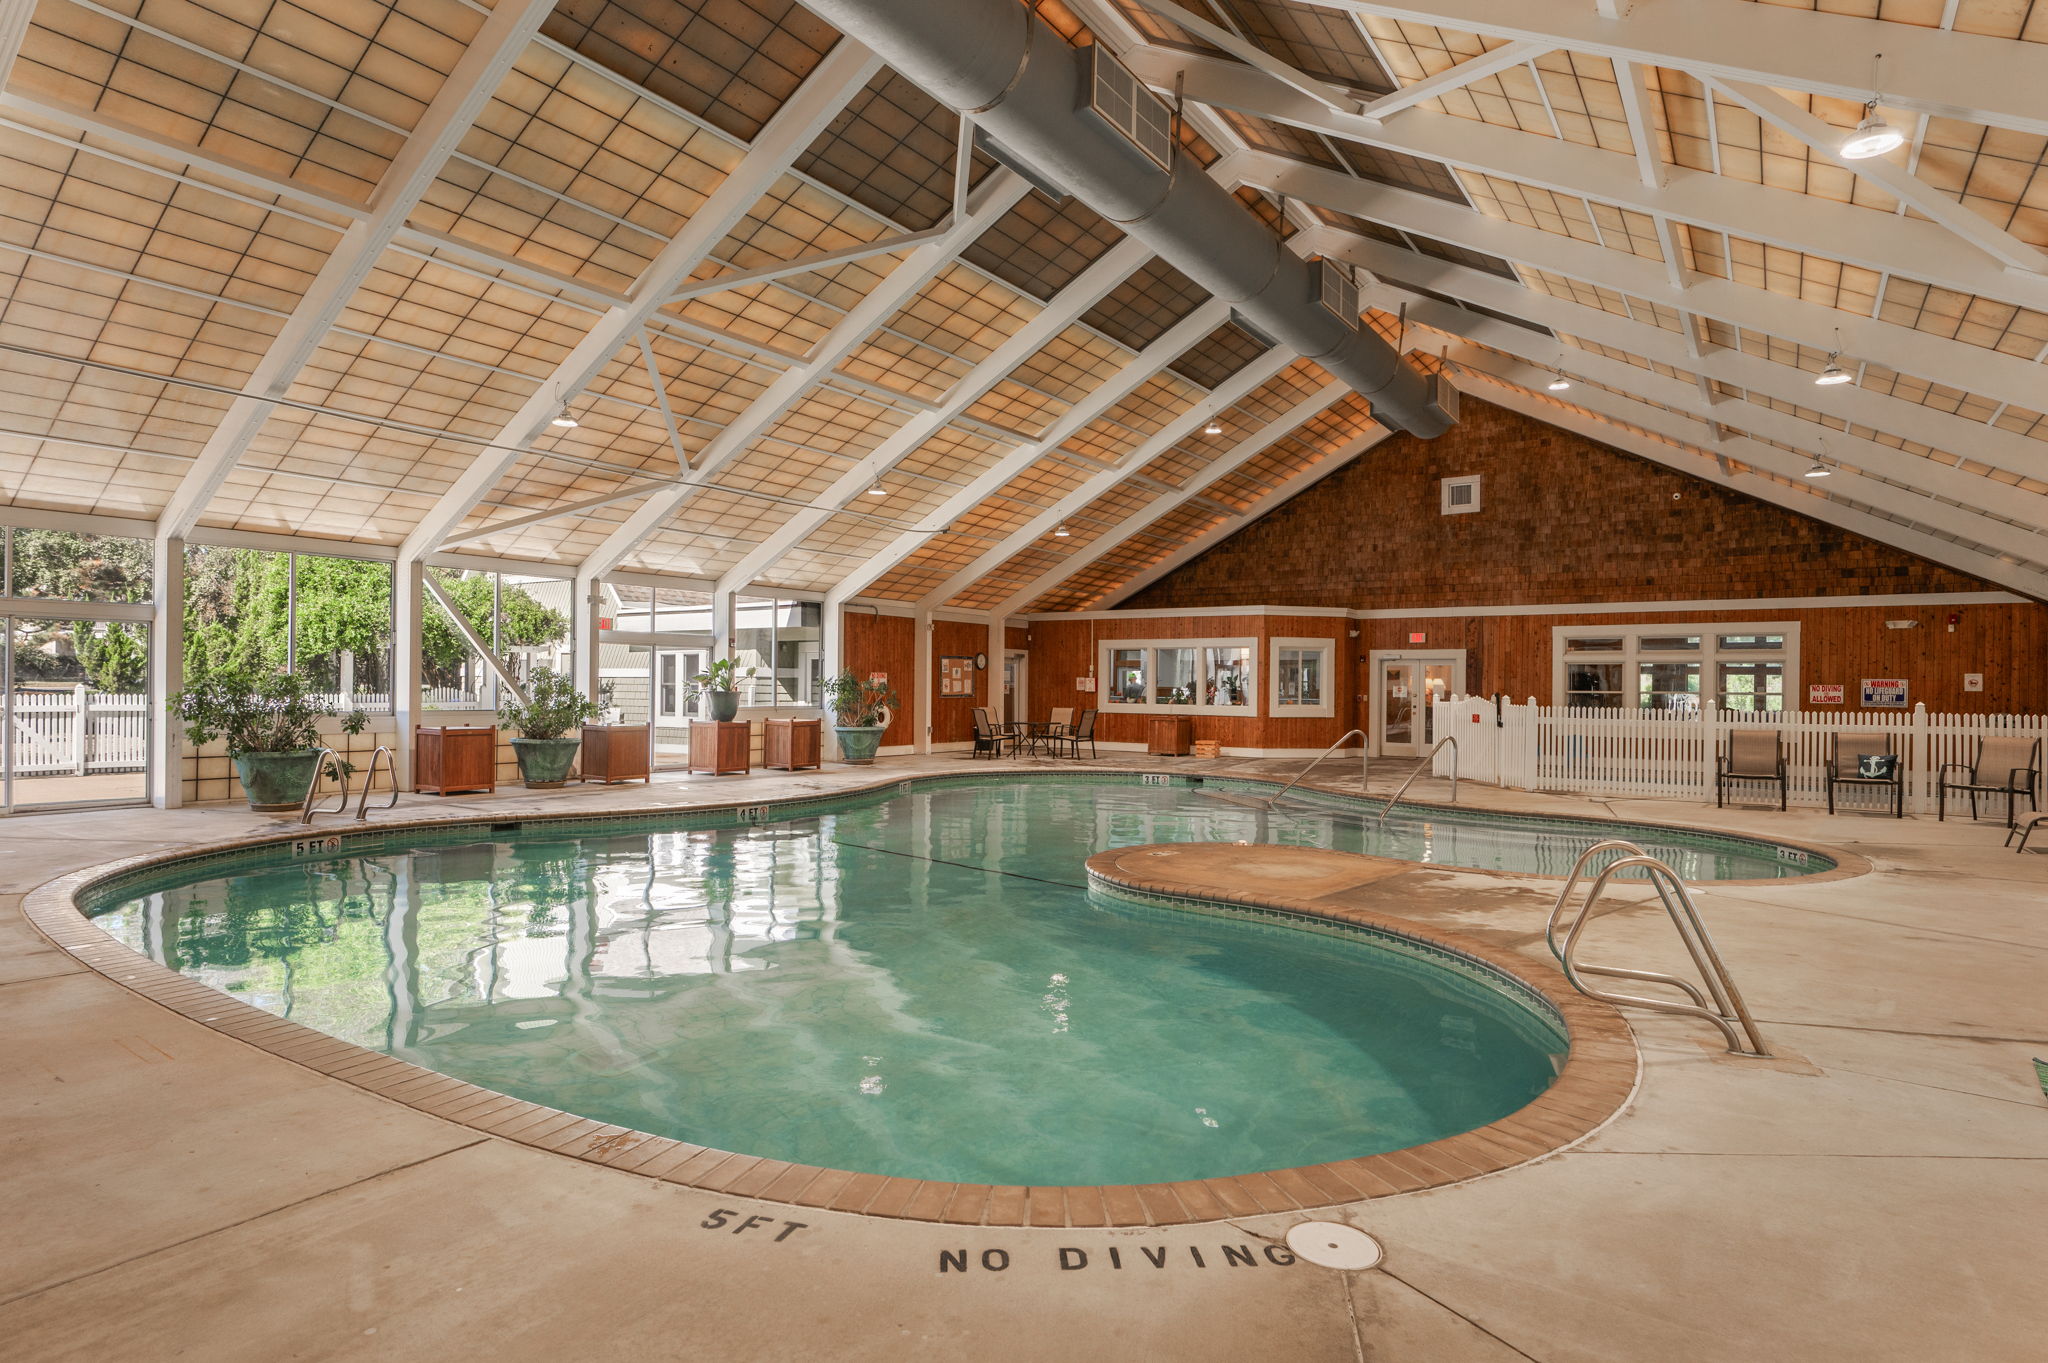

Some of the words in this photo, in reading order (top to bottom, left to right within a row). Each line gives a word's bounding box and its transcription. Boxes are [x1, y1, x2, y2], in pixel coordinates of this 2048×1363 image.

[1870, 680, 1899, 688] WARNING
[1812, 695, 1842, 703] ALLOWED
[1872, 694, 1881, 702] ON
[1881, 694, 1897, 702] DUTY
[1779, 849, 1785, 859] 3
[939, 1248, 1010, 1273] NO
[1058, 1244, 1296, 1271] DIVING
